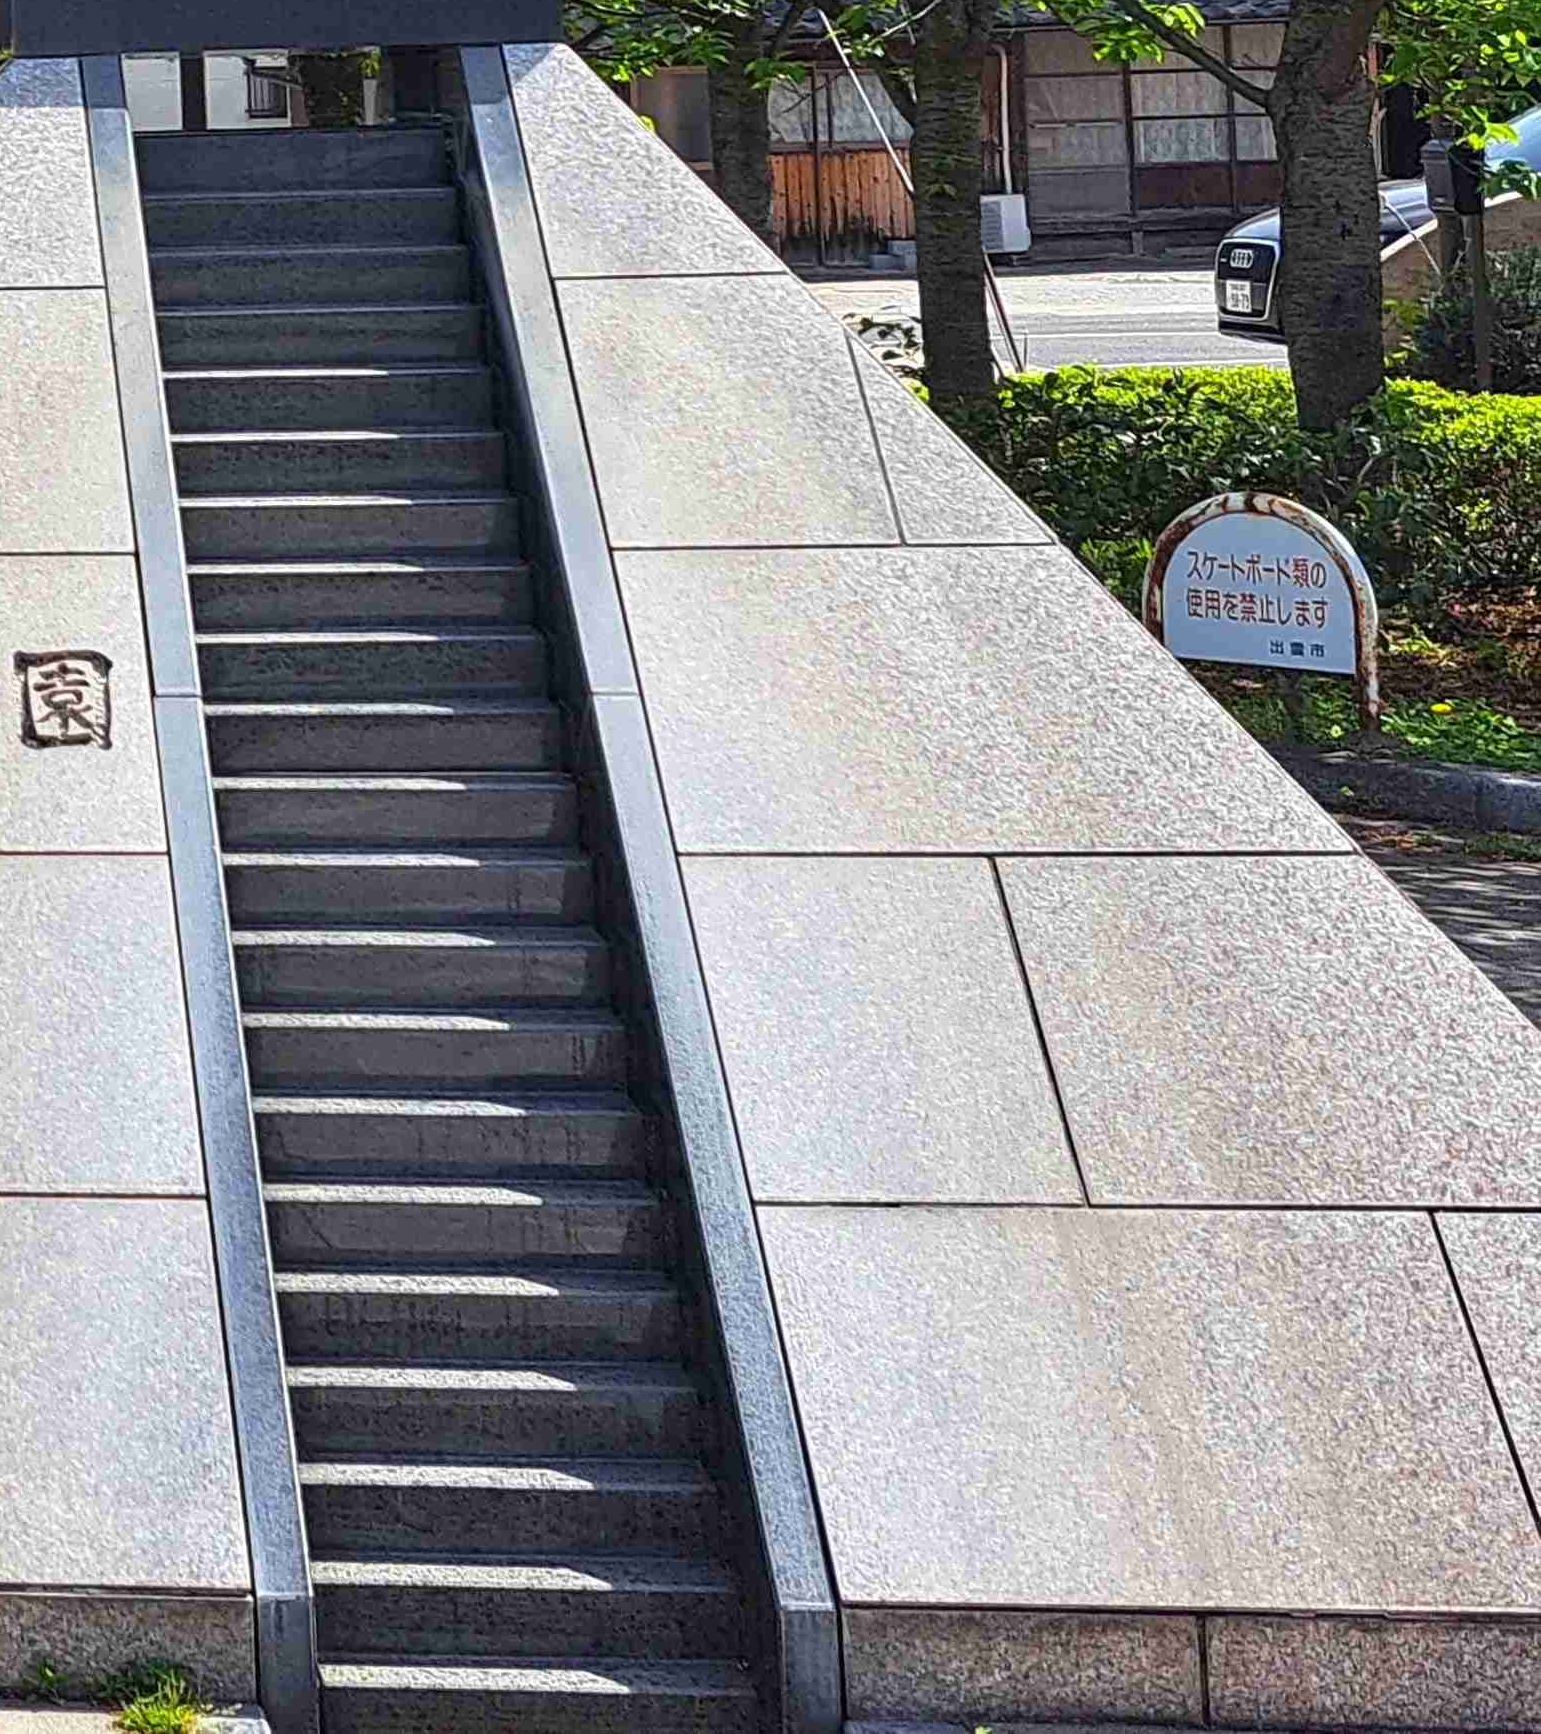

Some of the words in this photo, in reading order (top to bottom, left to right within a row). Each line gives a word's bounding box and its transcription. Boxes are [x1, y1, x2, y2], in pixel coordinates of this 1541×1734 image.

[1187, 551, 1327, 588] スケートボード類の
[1187, 588, 1328, 628] 使用を禁止します
